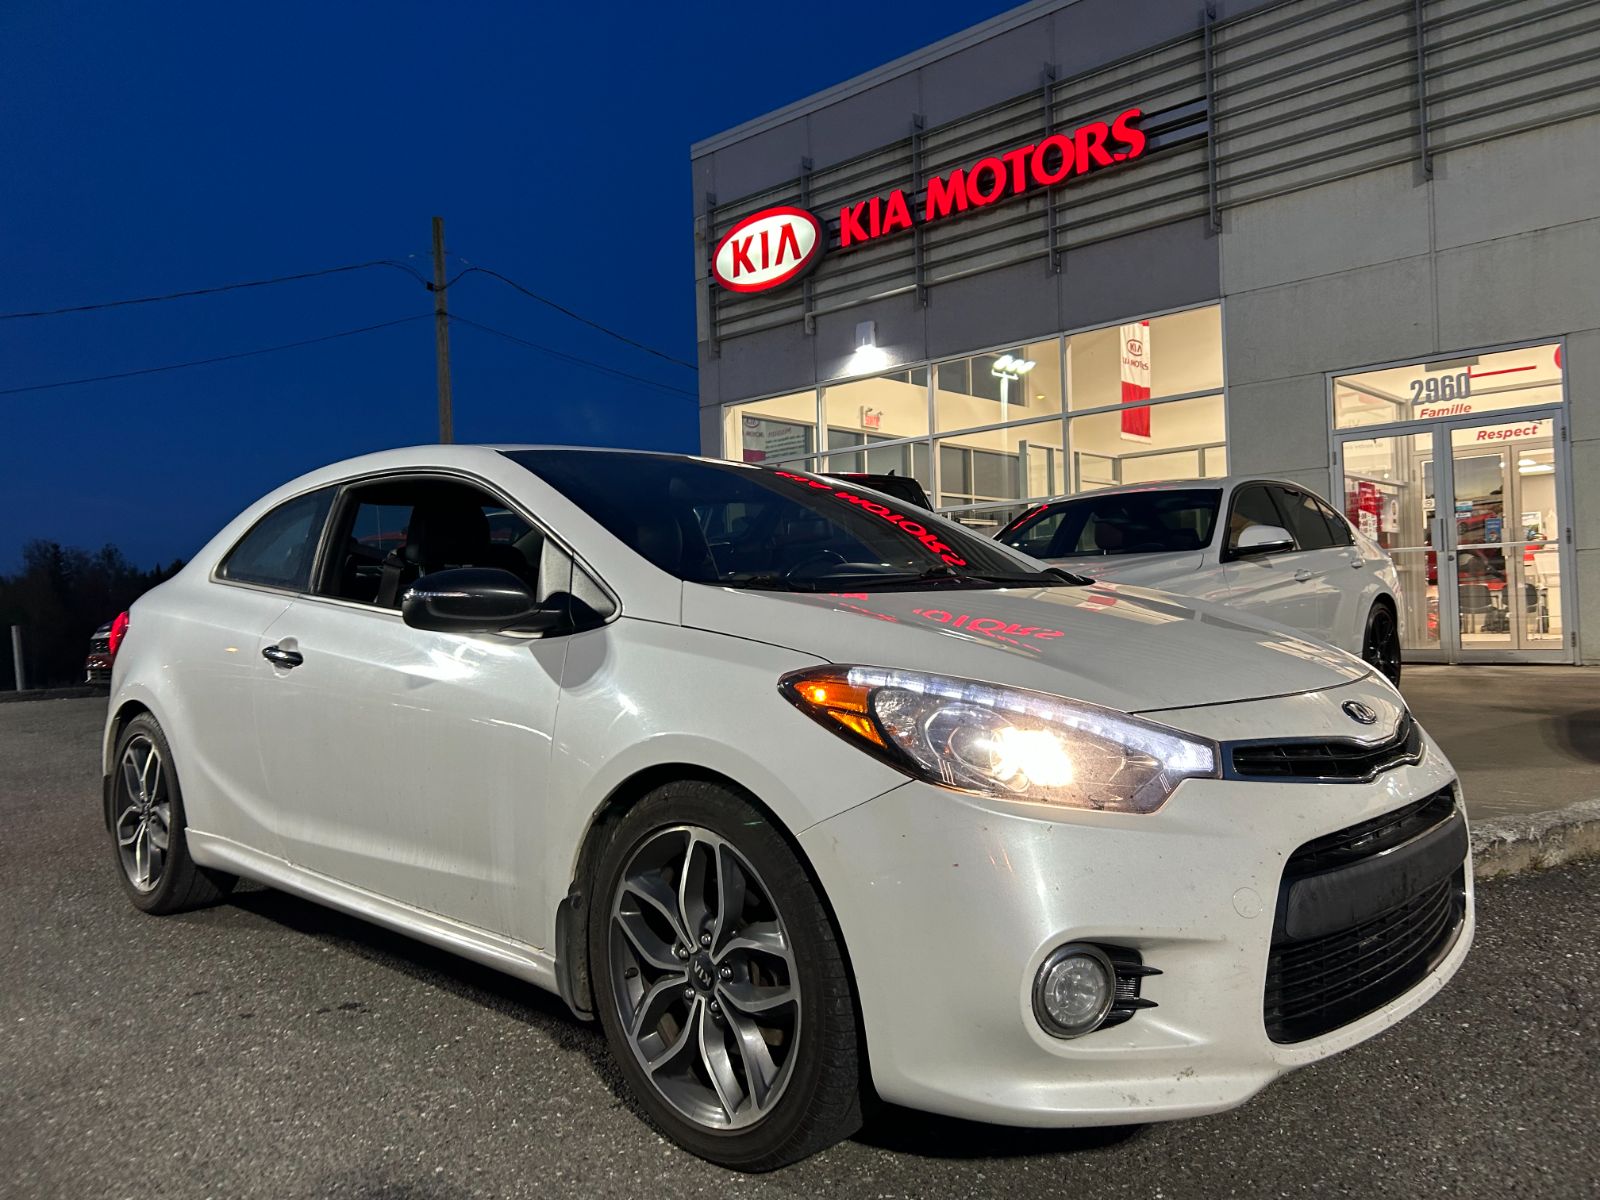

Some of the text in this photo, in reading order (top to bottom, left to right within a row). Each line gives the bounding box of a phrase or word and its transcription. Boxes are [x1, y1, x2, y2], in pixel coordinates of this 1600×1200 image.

[840, 108, 1146, 247] KIA MOTORS
[731, 222, 802, 278] KIA
[1410, 373, 1471, 406] 2960
[1420, 403, 1472, 418] Famille
[1476, 425, 1538, 441] Respect
[694, 960, 711, 987] KIA
